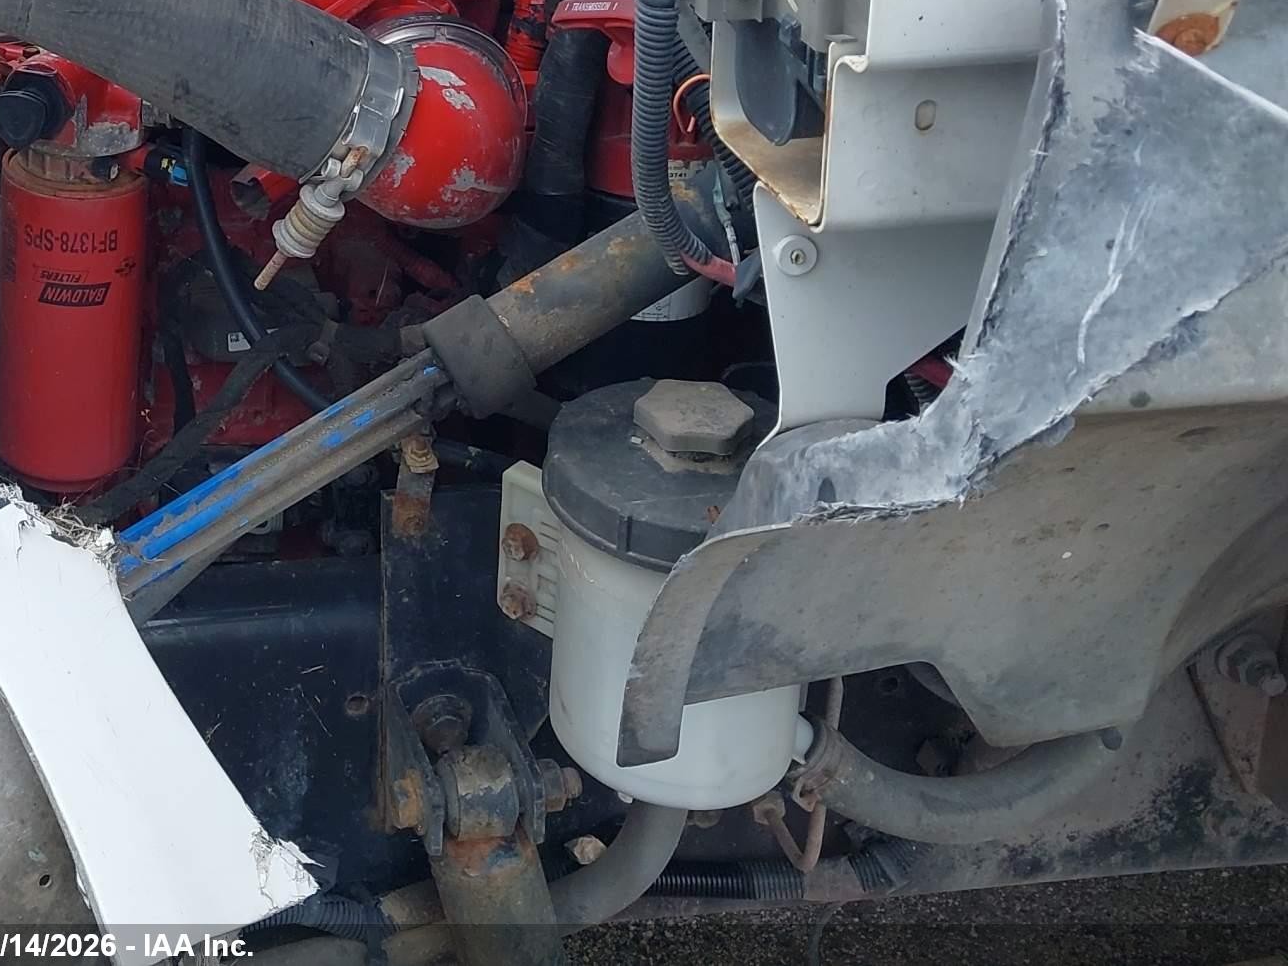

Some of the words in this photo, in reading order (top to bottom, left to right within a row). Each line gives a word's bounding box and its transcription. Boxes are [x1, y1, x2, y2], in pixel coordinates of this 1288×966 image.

[24, 224, 118, 254] BF1378-SPS
[40, 270, 82, 283] FILTERS
[44, 286, 106, 303] BALDWIN
